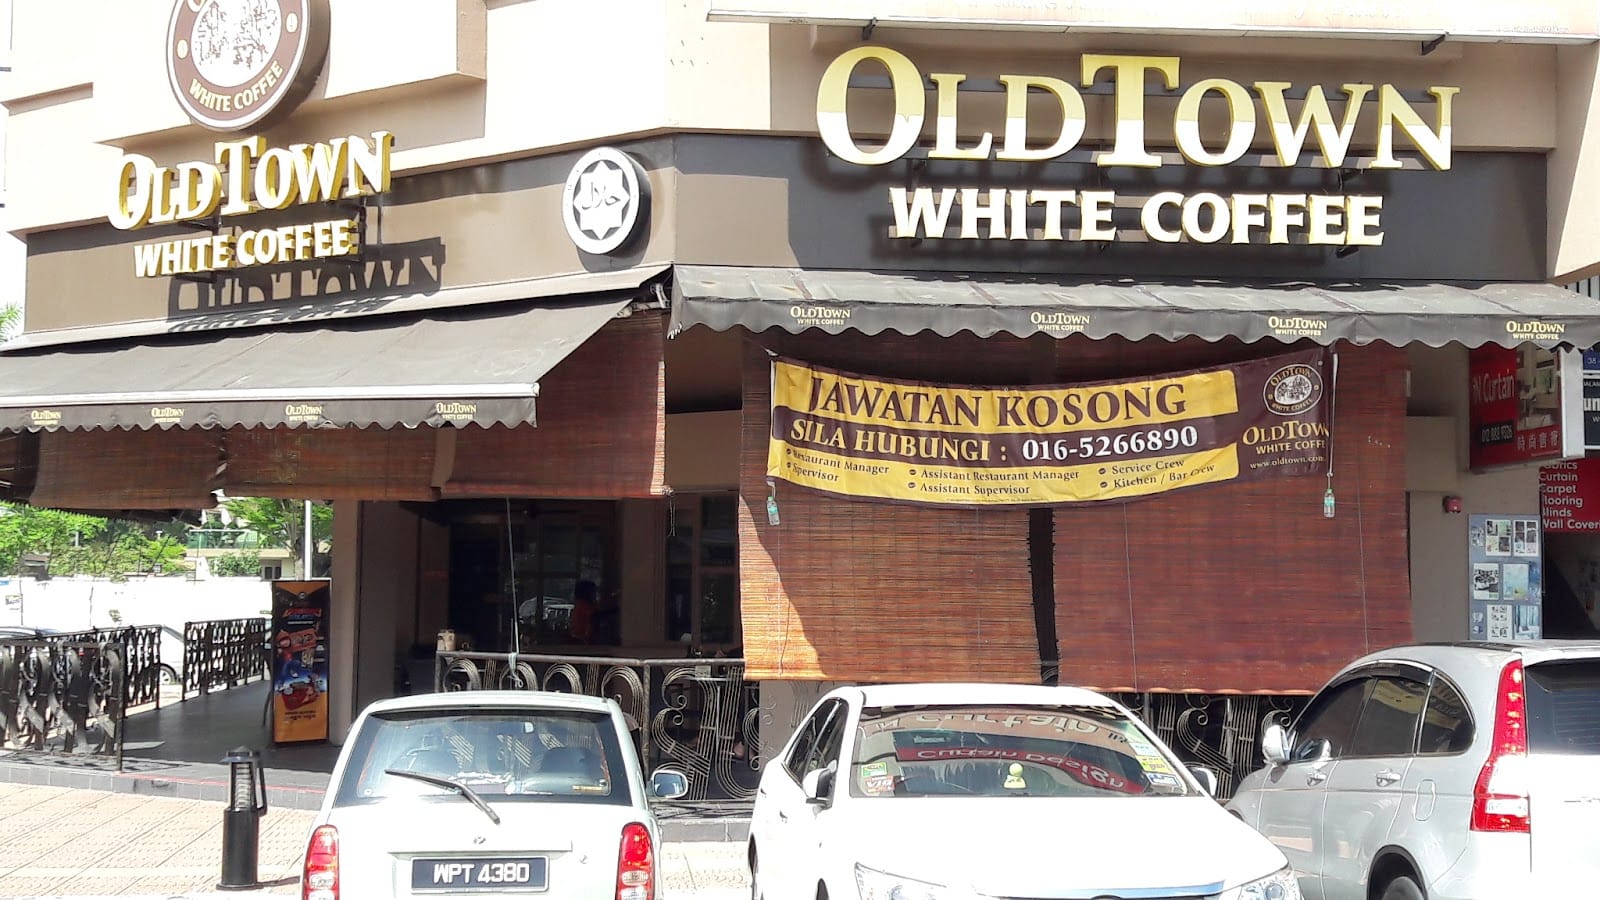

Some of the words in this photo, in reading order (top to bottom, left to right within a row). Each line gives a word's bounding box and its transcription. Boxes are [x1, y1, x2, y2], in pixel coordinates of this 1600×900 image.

[189, 78, 231, 112] WHITE
[233, 60, 283, 110] COFFEE
[815, 44, 1461, 171] OLDTOWN
[107, 130, 393, 230] OLDTOWN
[887, 186, 1116, 241] WHITE
[1140, 189, 1385, 247] COFFEE
[134, 234, 232, 278] WHITE
[236, 218, 358, 267] COFFEE
[808, 376, 982, 427] JAWATAN
[996, 383, 1186, 428] KOSONG
[790, 418, 847, 450] SILA
[854, 429, 990, 462] HUBUNGI
[1022, 425, 1198, 462] 016-5266890
[1256, 442, 1292, 455] WHITE
[844, 460, 890, 475] Manager
[920, 468, 972, 481] Assistant
[973, 469, 1029, 481] Restaurant
[1032, 469, 1080, 482] Manager
[1112, 462, 1152, 475] Service
[1155, 459, 1185, 470] Crew
[1539, 471, 1578, 481] Curtain
[920, 482, 971, 494] Assistant
[974, 483, 1031, 497] Supervisor
[1113, 473, 1157, 489] Kitchen
[1169, 471, 1187, 482] Bar
[433, 864, 475, 884] WPT
[477, 862, 530, 883] 4380
